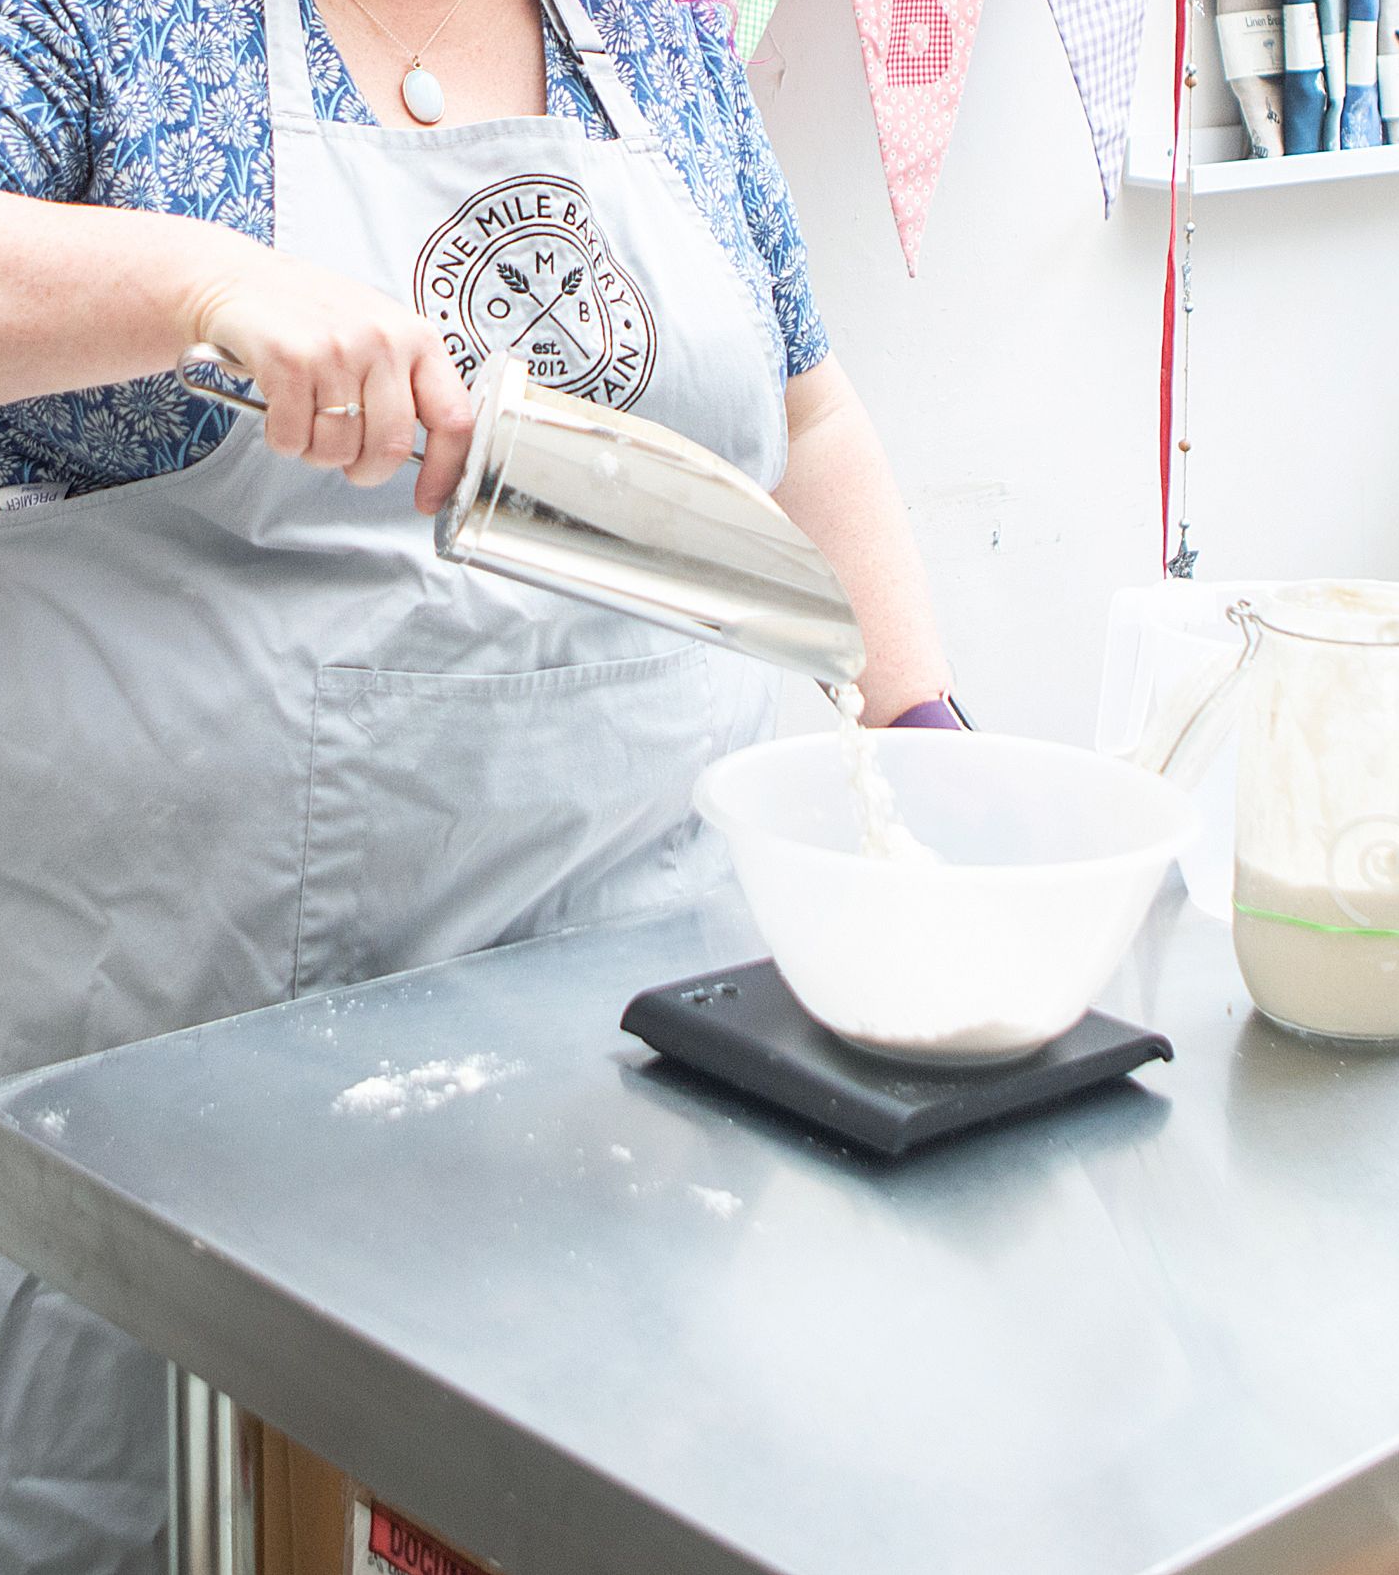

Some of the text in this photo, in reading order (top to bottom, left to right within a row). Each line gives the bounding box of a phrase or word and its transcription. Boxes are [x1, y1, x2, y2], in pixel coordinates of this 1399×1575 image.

[1244, 17, 1267, 29] Linen
[431, 194, 632, 308] ONE MILE BAKERY
[535, 251, 555, 276] M
[487, 297, 511, 320] O
[578, 301, 591, 324] B
[531, 340, 562, 357] est.
[527, 360, 569, 378] 2012
